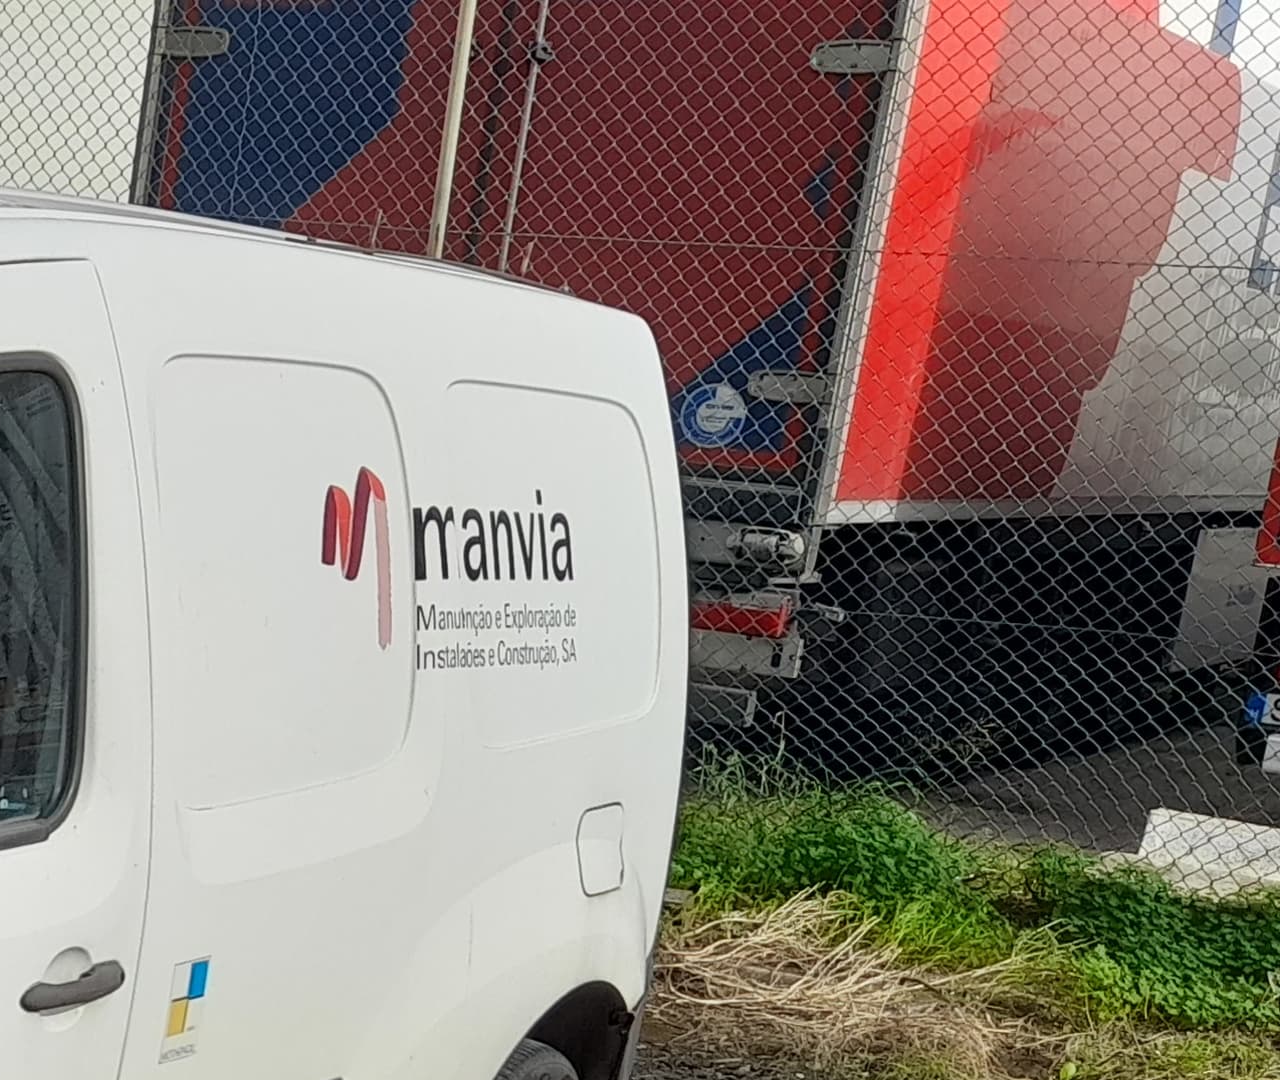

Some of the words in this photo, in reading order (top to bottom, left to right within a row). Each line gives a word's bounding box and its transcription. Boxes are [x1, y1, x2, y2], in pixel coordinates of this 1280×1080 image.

[412, 489, 574, 582] manvia
[495, 609, 502, 630] e
[504, 602, 562, 635] Exploração
[564, 603, 577, 628] de
[488, 647, 495, 667] e
[497, 638, 560, 671] Construção,
[561, 637, 577, 664] SA
